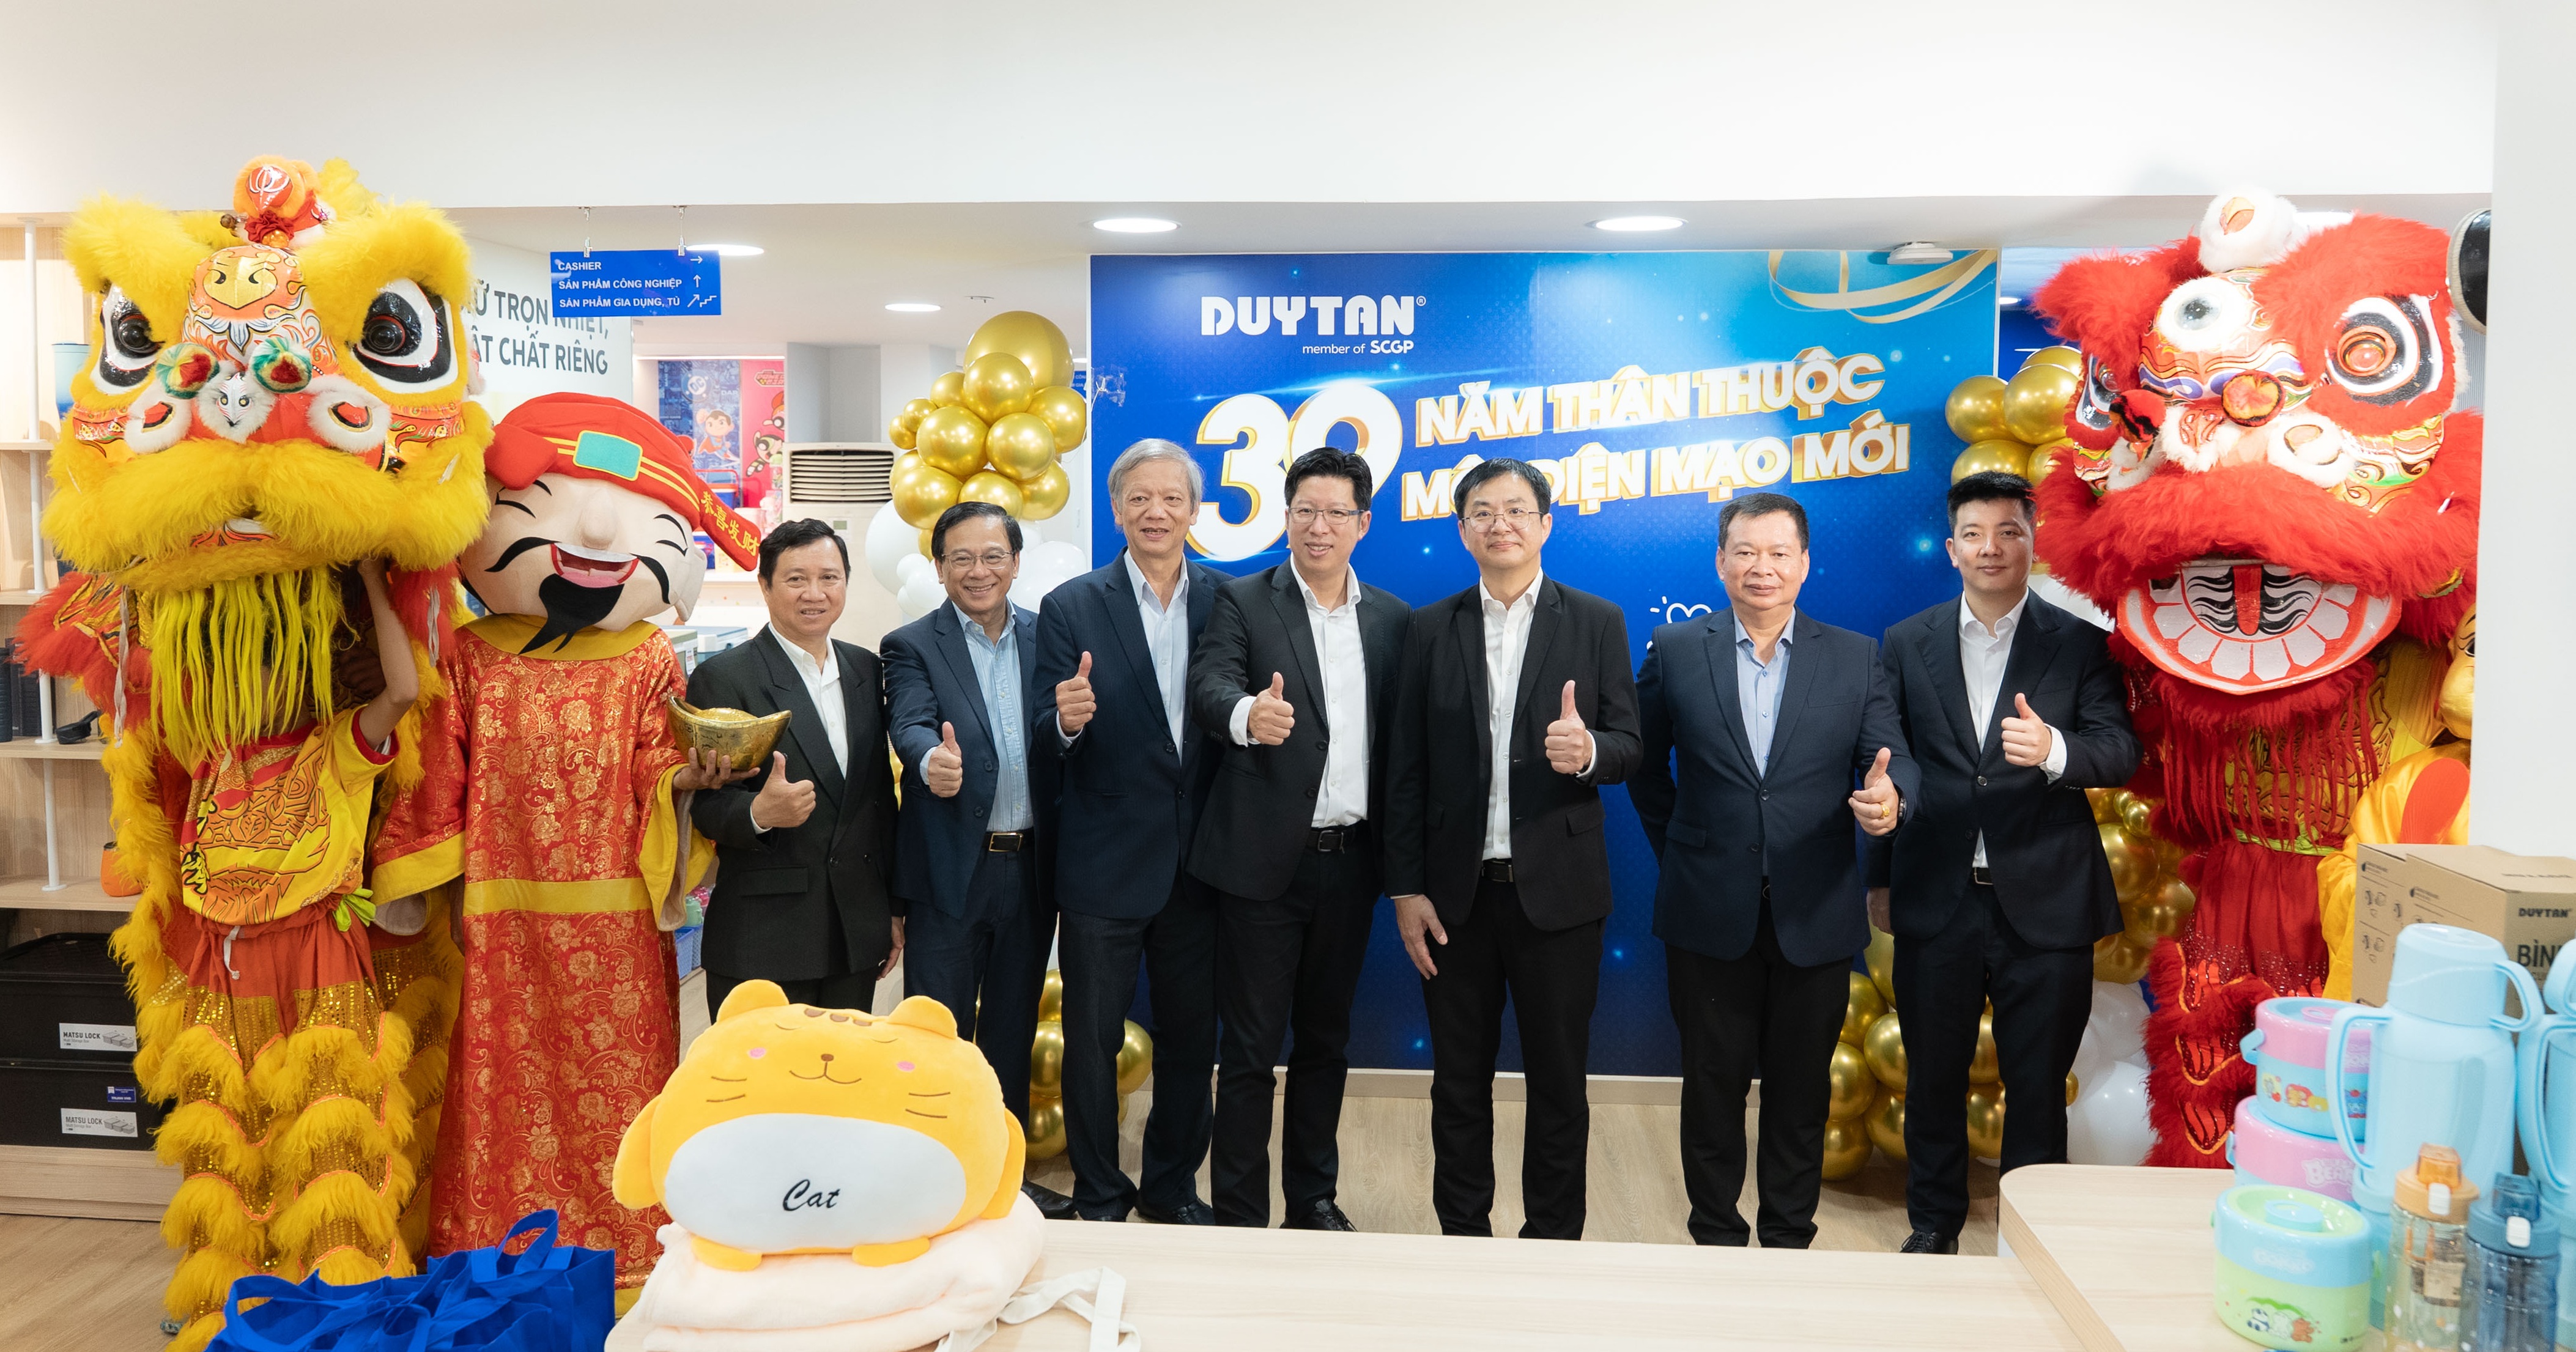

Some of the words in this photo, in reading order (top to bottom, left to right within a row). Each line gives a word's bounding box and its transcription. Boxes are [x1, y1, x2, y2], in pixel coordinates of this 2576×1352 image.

[558, 262, 602, 271] CASHIER
[558, 279, 579, 289] SẢN
[582, 278, 610, 289] PHẨM
[613, 278, 642, 289] CÔNG
[645, 277, 682, 289] NGHIỆP
[494, 290, 548, 331] TRỌN
[560, 297, 579, 308] SẢN
[583, 296, 611, 307] PHẨM
[613, 298, 631, 307] GIA
[634, 297, 665, 308] DỤNG,
[499, 330, 549, 369] CHẤT
[555, 339, 608, 375] RIÊNG
[1302, 344, 1350, 354] member
[1353, 343, 1365, 354] of
[1370, 340, 1414, 355] SCGP
[689, 377, 705, 391] DC
[1415, 380, 1544, 448] NĂM
[1547, 364, 1693, 434] THÂN
[1692, 345, 1886, 421] THUỘC
[1185, 379, 1403, 561] 39
[1650, 436, 1791, 503] MẠO
[1791, 408, 1911, 483] MỚI
[701, 491, 760, 556] 恭喜发财
[2518, 939, 2561, 967] BÌN
[782, 1179, 840, 1211] Cat
